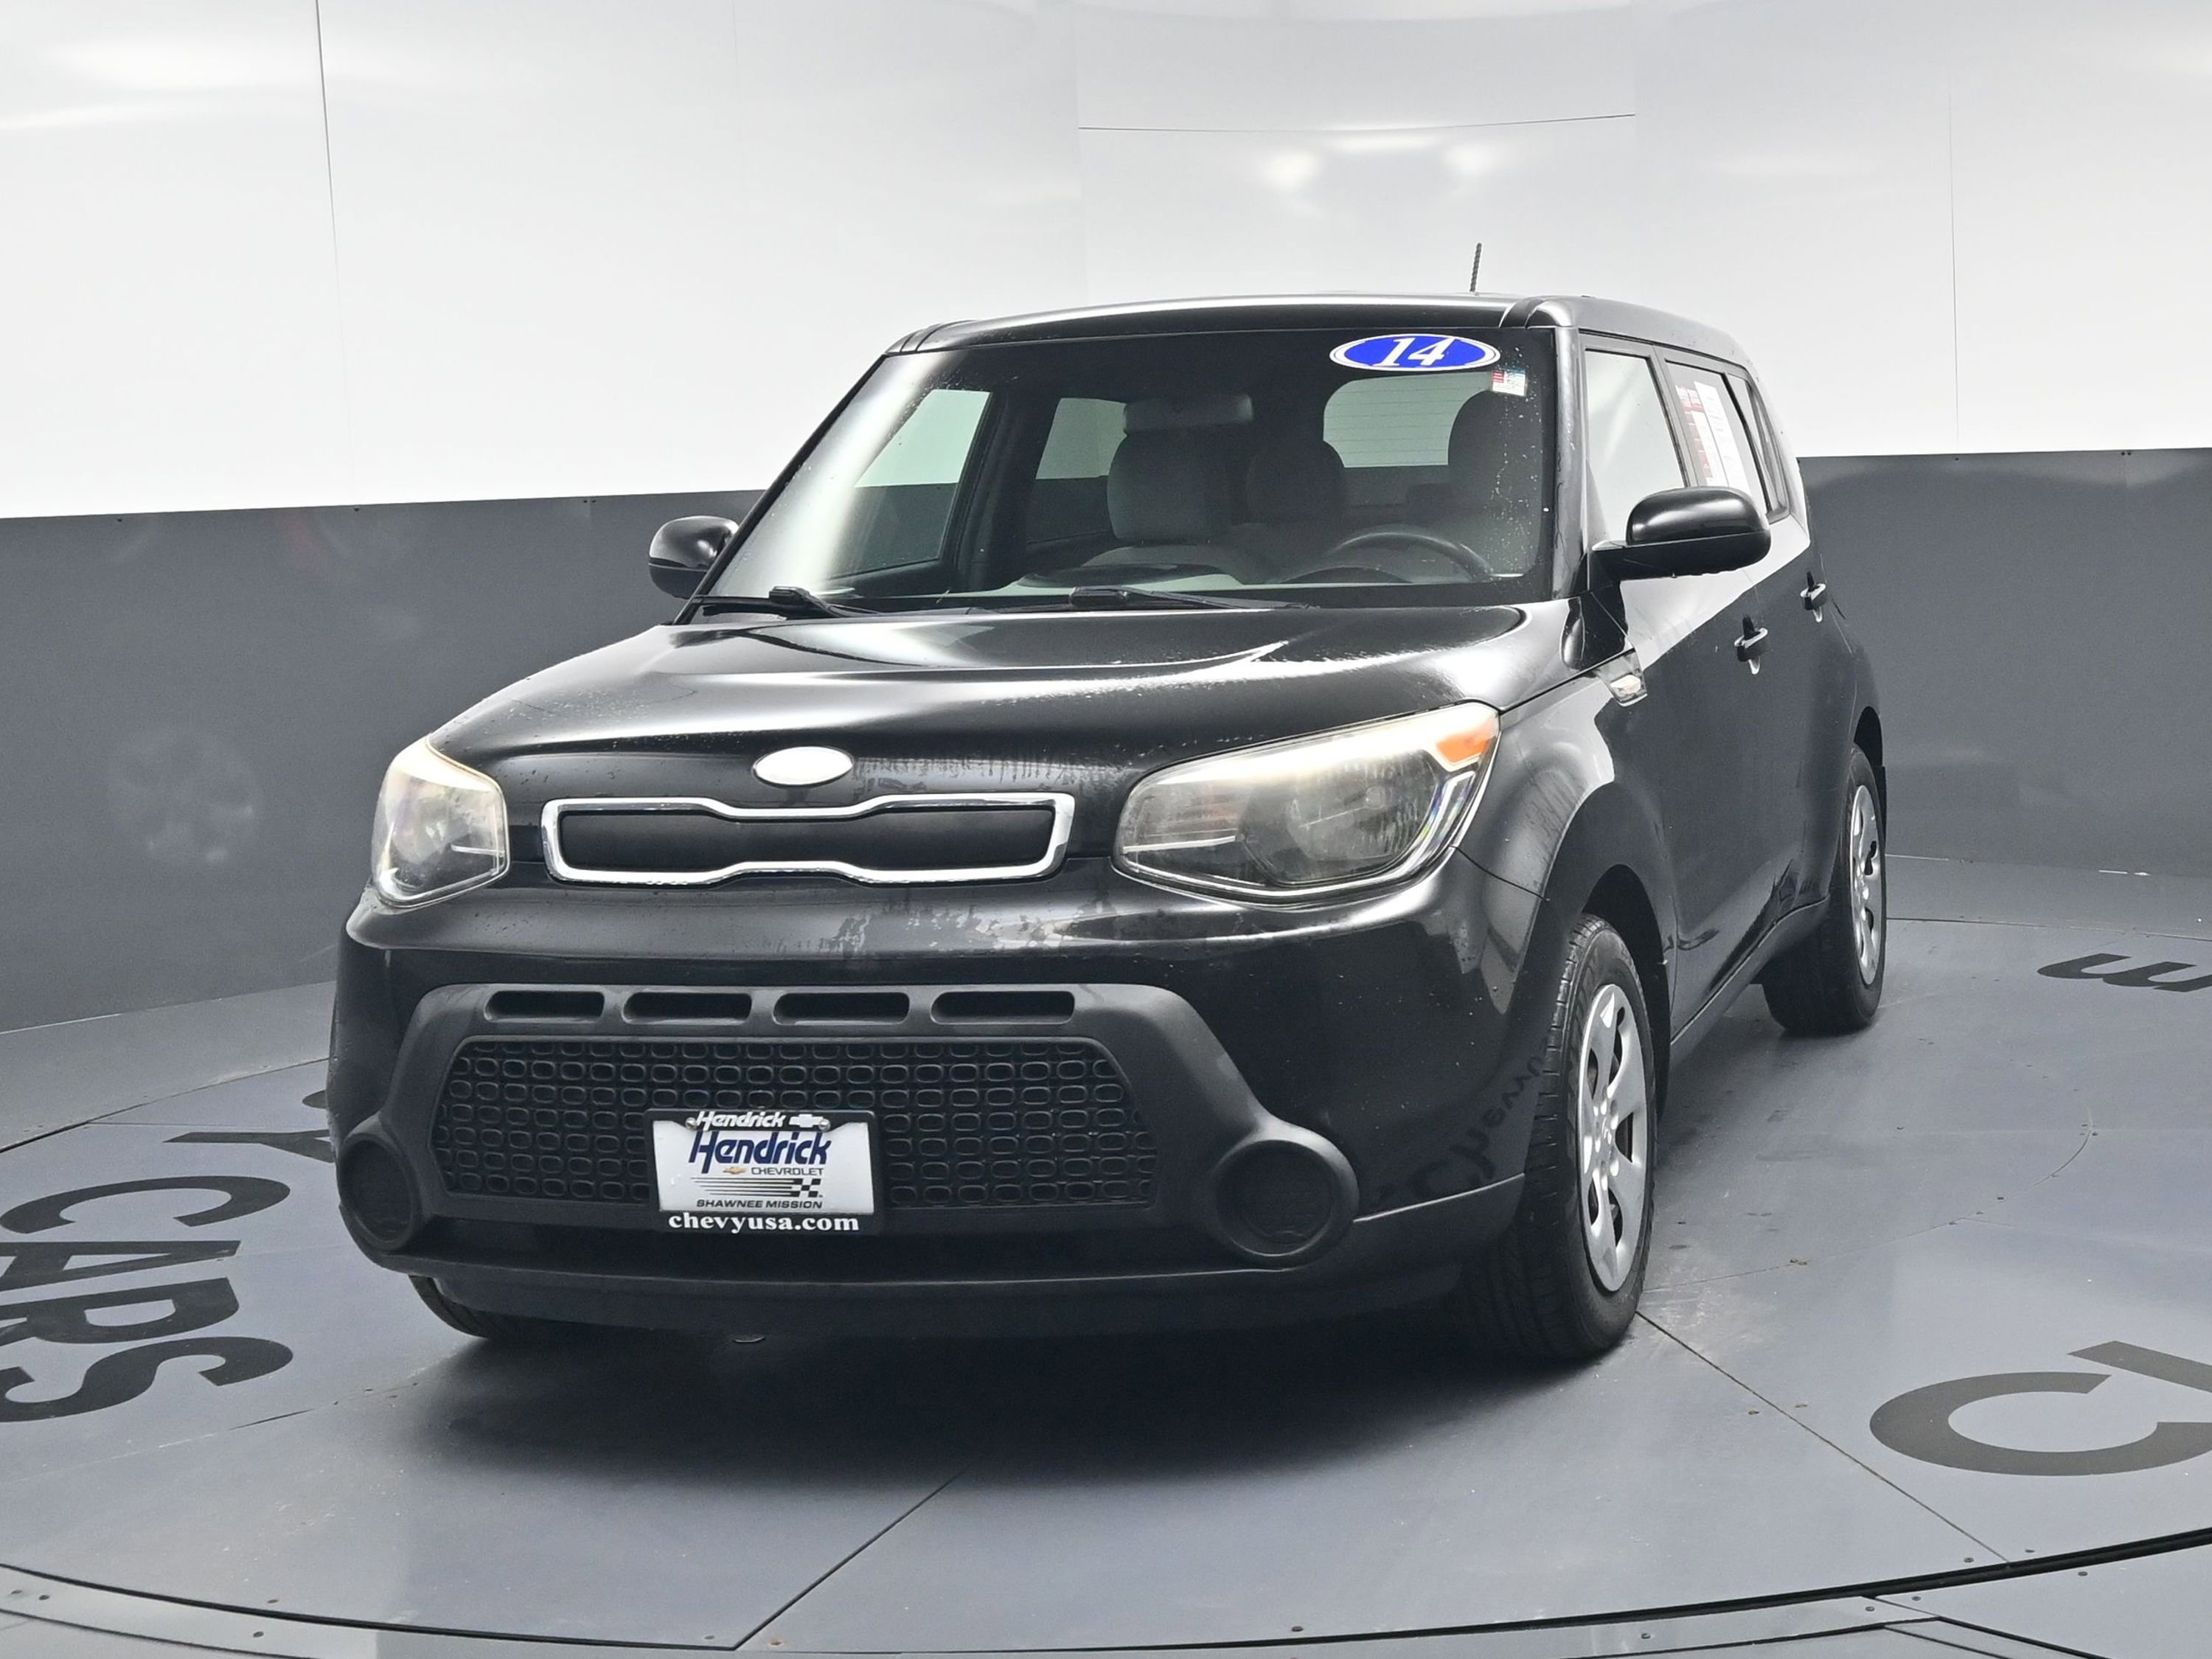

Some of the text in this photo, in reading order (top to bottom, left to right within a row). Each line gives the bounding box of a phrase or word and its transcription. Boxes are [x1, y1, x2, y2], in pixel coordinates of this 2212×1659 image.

[1371, 337, 1456, 366] 14
[695, 1110, 786, 1131] Hendrick
[688, 1131, 832, 1174] Hendrick
[751, 1167, 824, 1176] CHEVROLET
[696, 1199, 823, 1209] SHAWNEE MISSION
[668, 1212, 860, 1234] chevyusa.com
